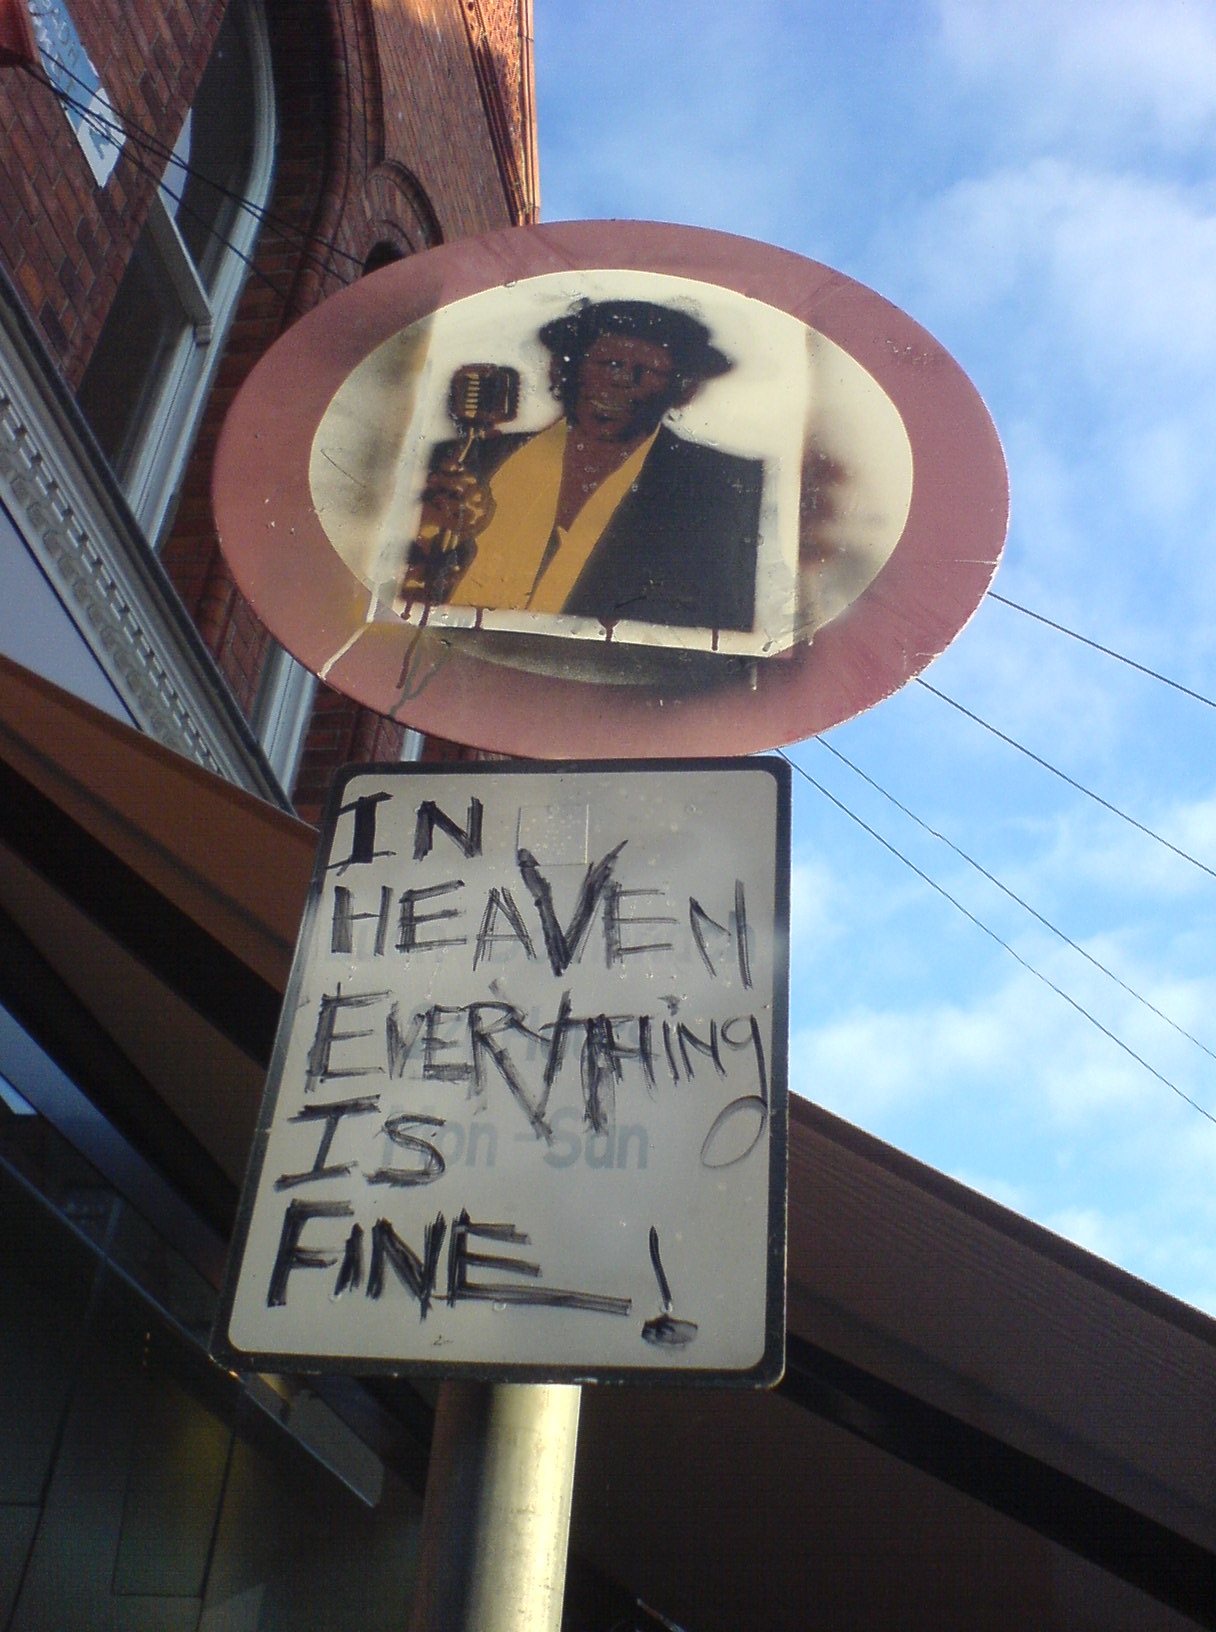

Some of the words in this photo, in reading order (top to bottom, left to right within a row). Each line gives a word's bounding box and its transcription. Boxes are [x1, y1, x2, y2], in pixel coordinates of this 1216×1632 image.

[327, 791, 484, 875] IN
[330, 839, 755, 990] HEAVEN
[274, 1094, 446, 1188] IS
